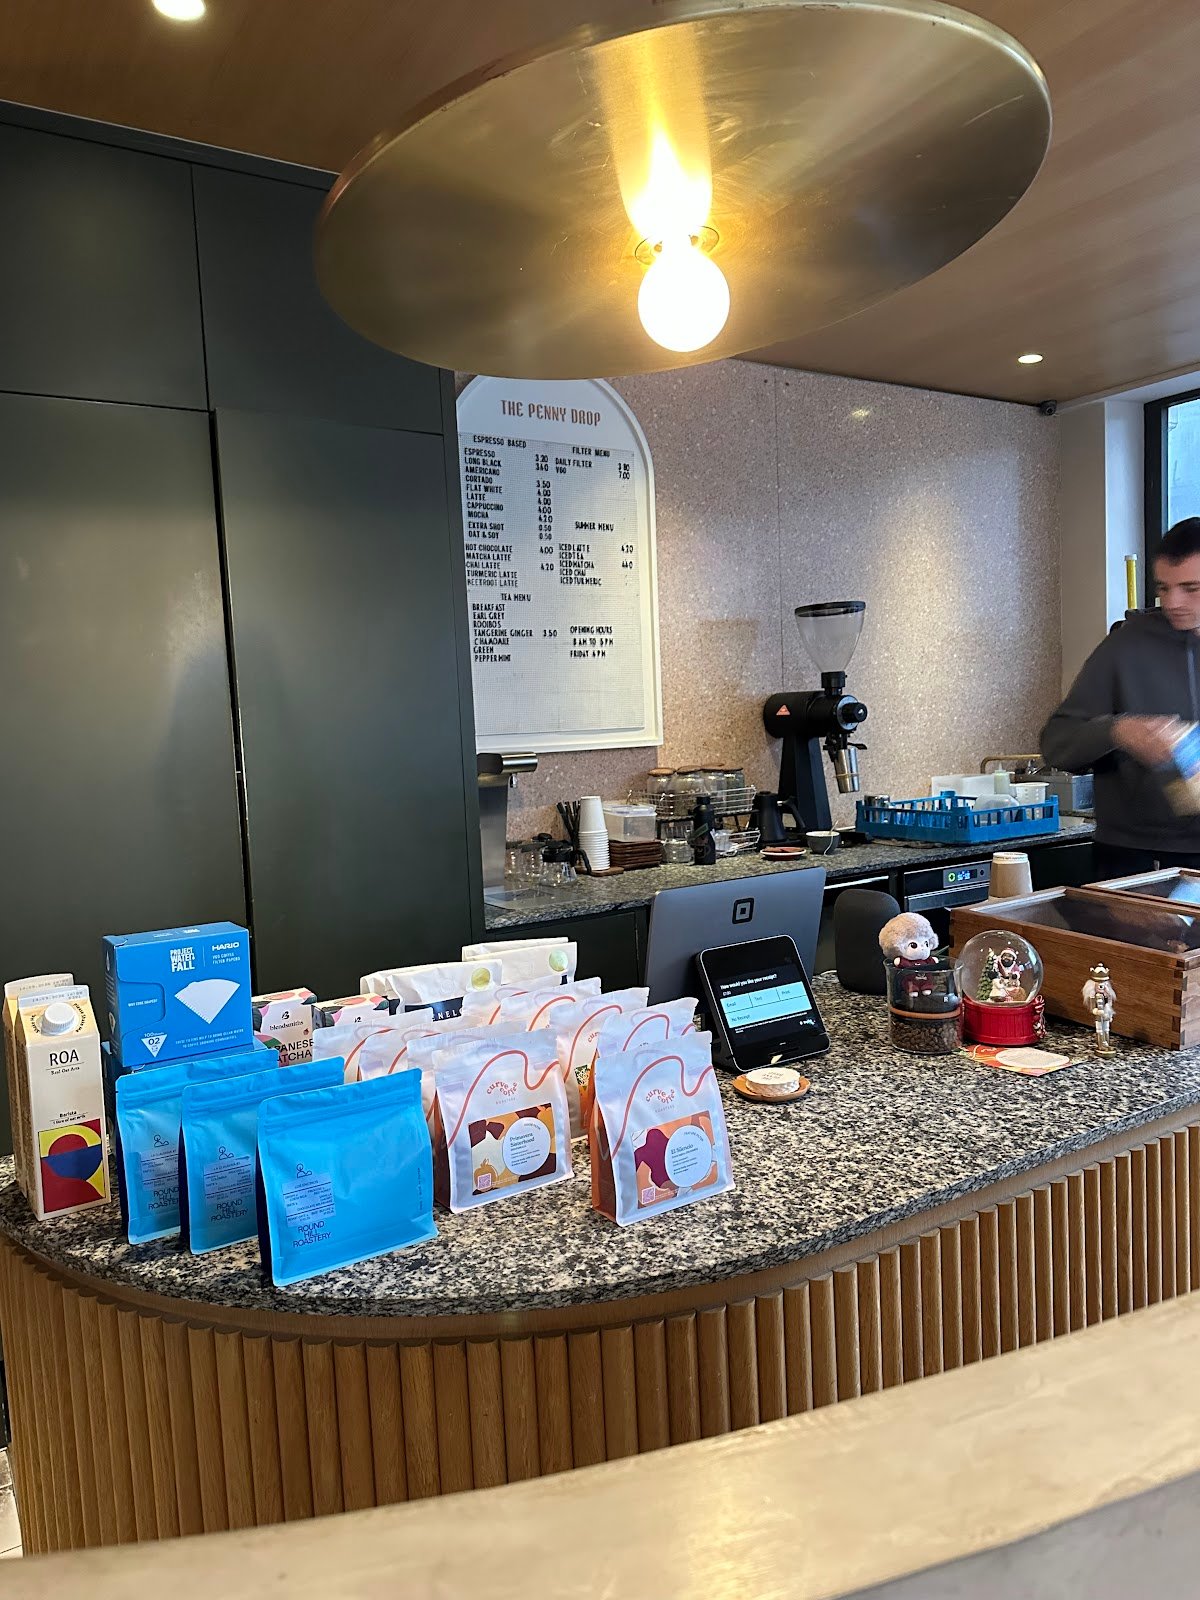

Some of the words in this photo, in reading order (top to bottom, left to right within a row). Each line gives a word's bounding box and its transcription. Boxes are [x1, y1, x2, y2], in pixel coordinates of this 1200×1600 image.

[501, 400, 524, 417] THE
[528, 403, 567, 422] PENNY
[571, 409, 601, 427] DROP
[473, 435, 505, 446] ESPRESSO
[508, 439, 527, 449] BASED
[464, 447, 496, 458] ESPRESSO
[572, 446, 592, 457] FILTER
[595, 449, 611, 458] MENU
[464, 456, 481, 466] LONG
[482, 458, 502, 468] BLACK
[555, 457, 571, 466] DAILY
[572, 459, 593, 468] FILTER
[465, 465, 501, 476] AMERICANO
[465, 474, 493, 485] CORTADO
[466, 484, 482, 493] FLAT
[484, 485, 503, 494] WHITE
[466, 493, 487, 502] LATTE
[467, 501, 504, 512] CAPPUCCINO
[467, 510, 489, 519] MOCHA
[468, 522, 488, 531] EXTRA
[489, 522, 505, 531] SHOT
[575, 521, 596, 531] SUMMER
[598, 523, 615, 533] MENU
[468, 531, 482, 539] OAT
[488, 532, 500, 540] SOY
[465, 543, 478, 552] HOT
[478, 544, 513, 554] CHOCOLATE
[466, 552, 492, 561] MATCHA
[492, 553, 511, 562] LATTE
[465, 560, 480, 569] CHAI
[481, 561, 501, 570] LATTE
[466, 569, 498, 579] TURMERIC
[499, 570, 518, 580] LATTE
[467, 578, 498, 588] BEETROOT
[499, 579, 518, 588] LATTE
[501, 593, 512, 602] TEA
[513, 593, 532, 602] MENU
[472, 603, 506, 612] BREAKFAST
[473, 612, 488, 620] EARL
[488, 612, 505, 620] GREY
[473, 620, 502, 629] ROOIBOS
[569, 625, 594, 635] OPENING
[595, 626, 613, 635] HOURS
[474, 629, 508, 638] TANGERINE
[510, 629, 534, 638] GINGER
[473, 646, 494, 655] GREEN
[569, 650, 590, 659] FRIDAY
[474, 654, 512, 664] PEPPERMINT
[169, 946, 194, 957] PROJECT
[211, 941, 240, 952] HARIO
[171, 960, 195, 973] FALL
[269, 1020, 304, 1031] blendsmiths
[148, 1037, 161, 1046] 02
[49, 1049, 79, 1066] ROA
[277, 1049, 313, 1064] ATCHA
[486, 1081, 509, 1096] curve
[499, 1082, 518, 1097] coffee
[645, 1088, 667, 1103] curve
[60, 1110, 77, 1118] Barista
[154, 1187, 179, 1197] ROUND
[148, 1197, 179, 1210] ROASTE
[217, 1199, 243, 1211] ROUND
[211, 1208, 249, 1222] ROASTERY
[298, 1220, 325, 1234] ROUND
[293, 1231, 332, 1248] ROASTERY
